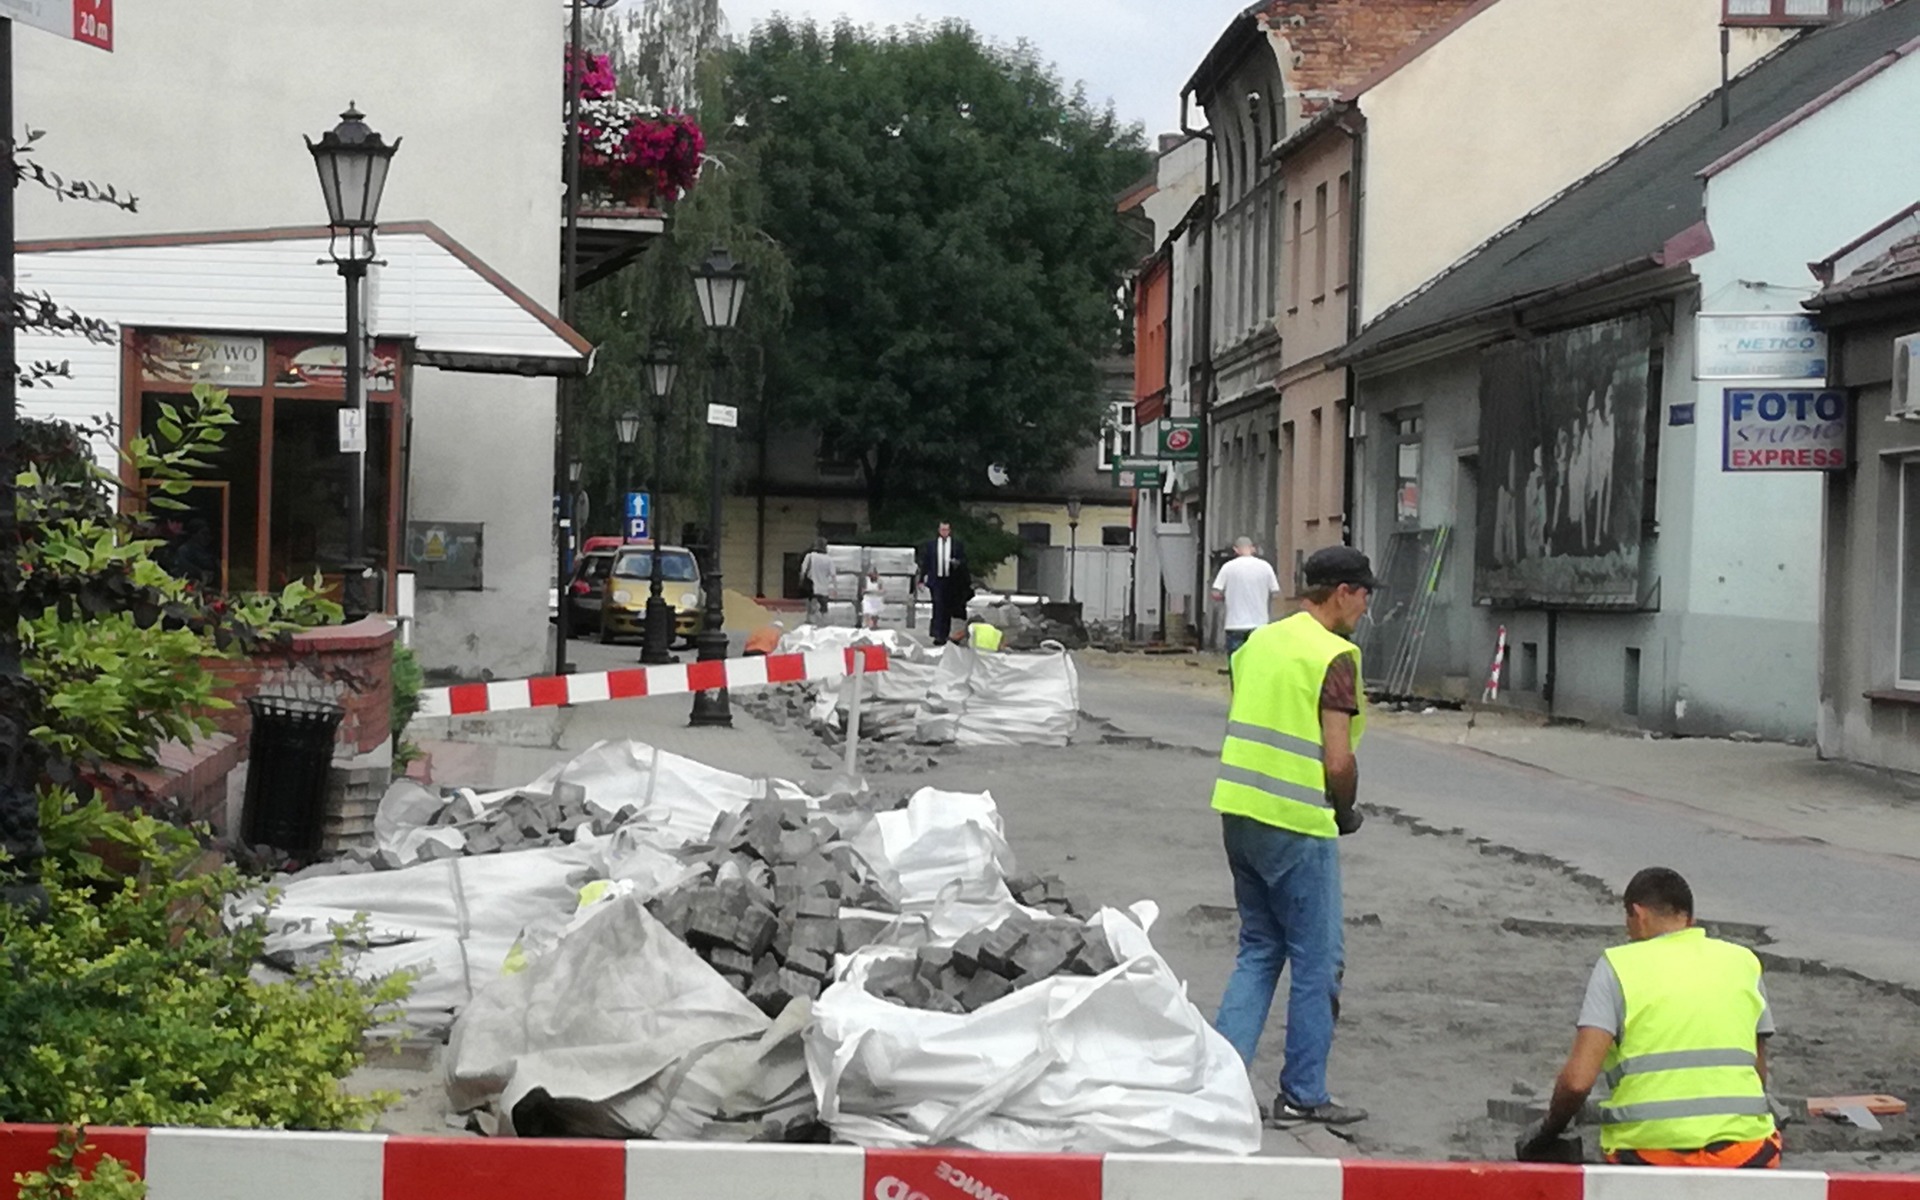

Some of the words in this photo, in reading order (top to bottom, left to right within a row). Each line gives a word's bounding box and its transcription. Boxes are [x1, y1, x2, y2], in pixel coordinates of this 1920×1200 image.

[80, 11, 96, 37] 20
[96, 22, 108, 41] m
[1732, 392, 1846, 422] FOTO
[1737, 424, 1845, 443] STUDIO
[1732, 449, 1845, 467] EXPRESS
[631, 519, 645, 537] P
